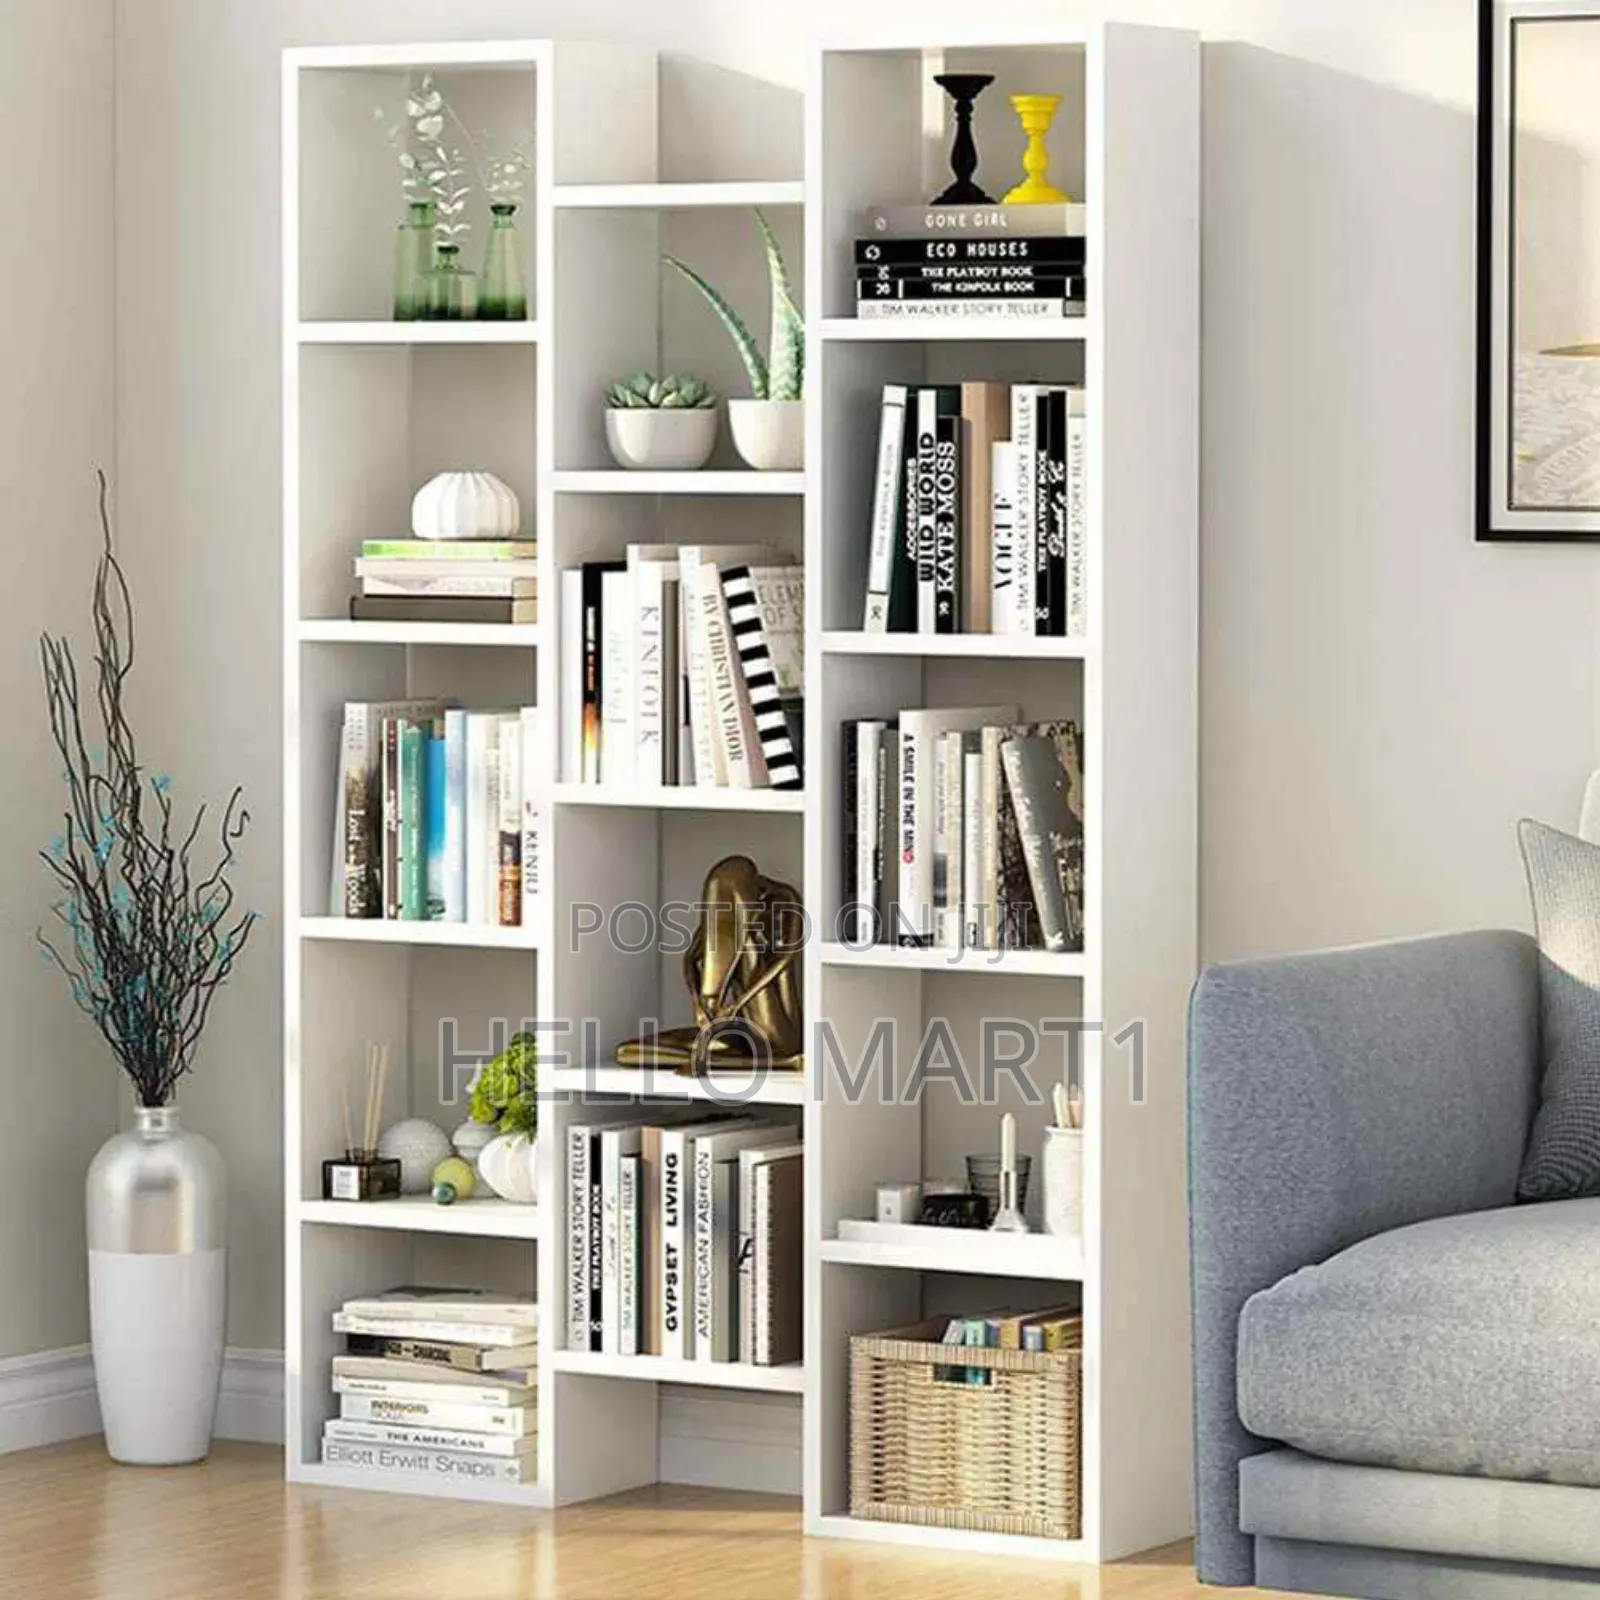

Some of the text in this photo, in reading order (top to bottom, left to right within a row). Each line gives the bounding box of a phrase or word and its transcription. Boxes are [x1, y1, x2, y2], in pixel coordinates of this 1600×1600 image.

[924, 211, 966, 229] GONE
[926, 241, 1029, 258] ECO HOUSES
[906, 457, 918, 561] ACCESSORIES
[936, 441, 955, 592] KATE MOSS
[571, 1132, 586, 1323] TIM WALKER STORY TELLER
[665, 1152, 679, 1333] GYPSET LIVING
[696, 1151, 711, 1339] AMERICAN FASHION
[386, 1431, 409, 1442] THE
[412, 1434, 485, 1449] AMERICANS
[435, 1455, 497, 1479] Snaps
